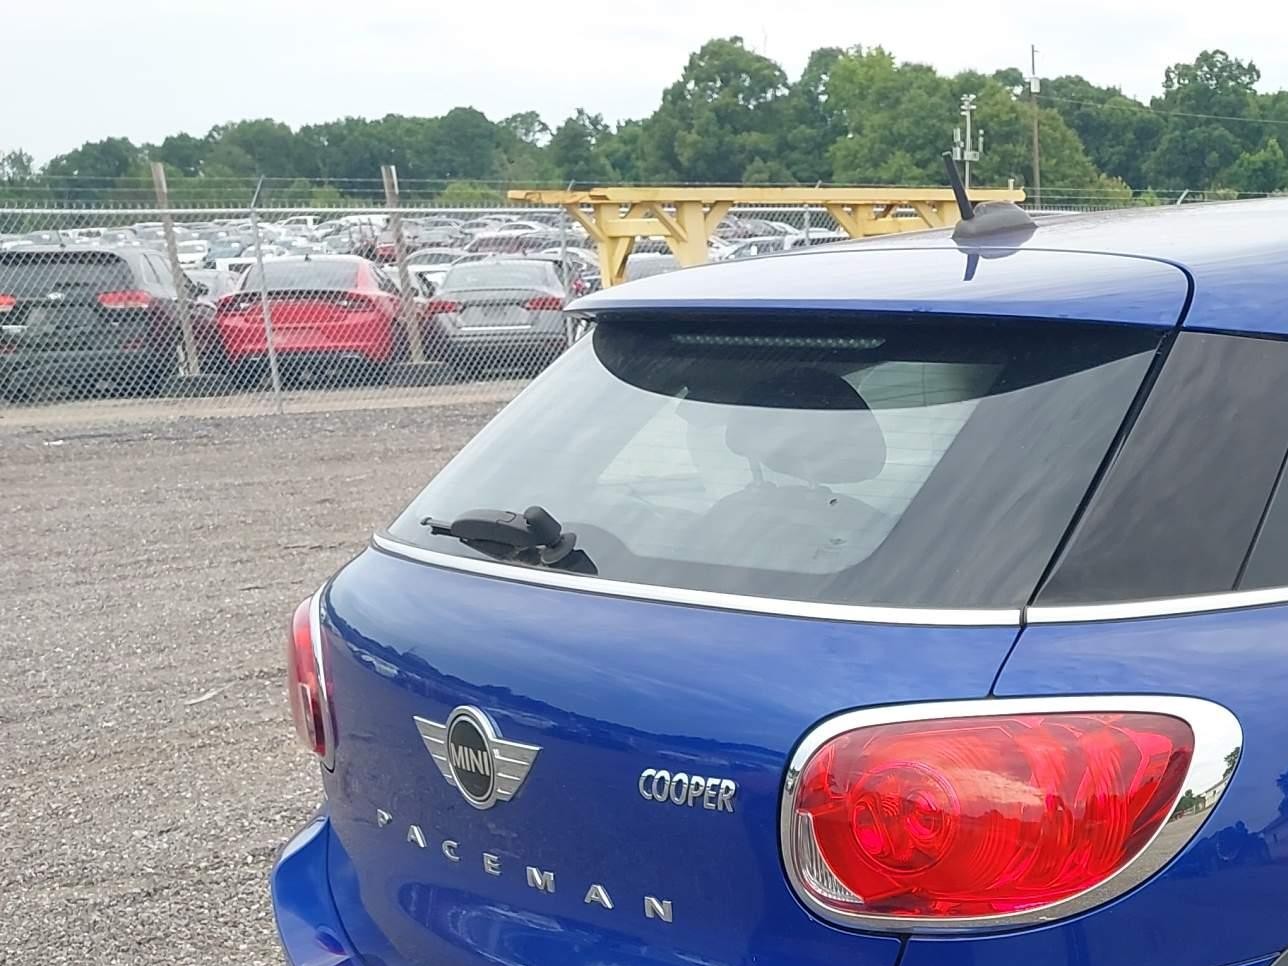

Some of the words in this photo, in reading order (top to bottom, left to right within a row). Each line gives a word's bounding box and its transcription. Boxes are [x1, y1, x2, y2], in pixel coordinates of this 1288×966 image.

[450, 742, 491, 777] MINI
[639, 768, 736, 812] COOPER
[376, 808, 673, 923] PACEMAN
